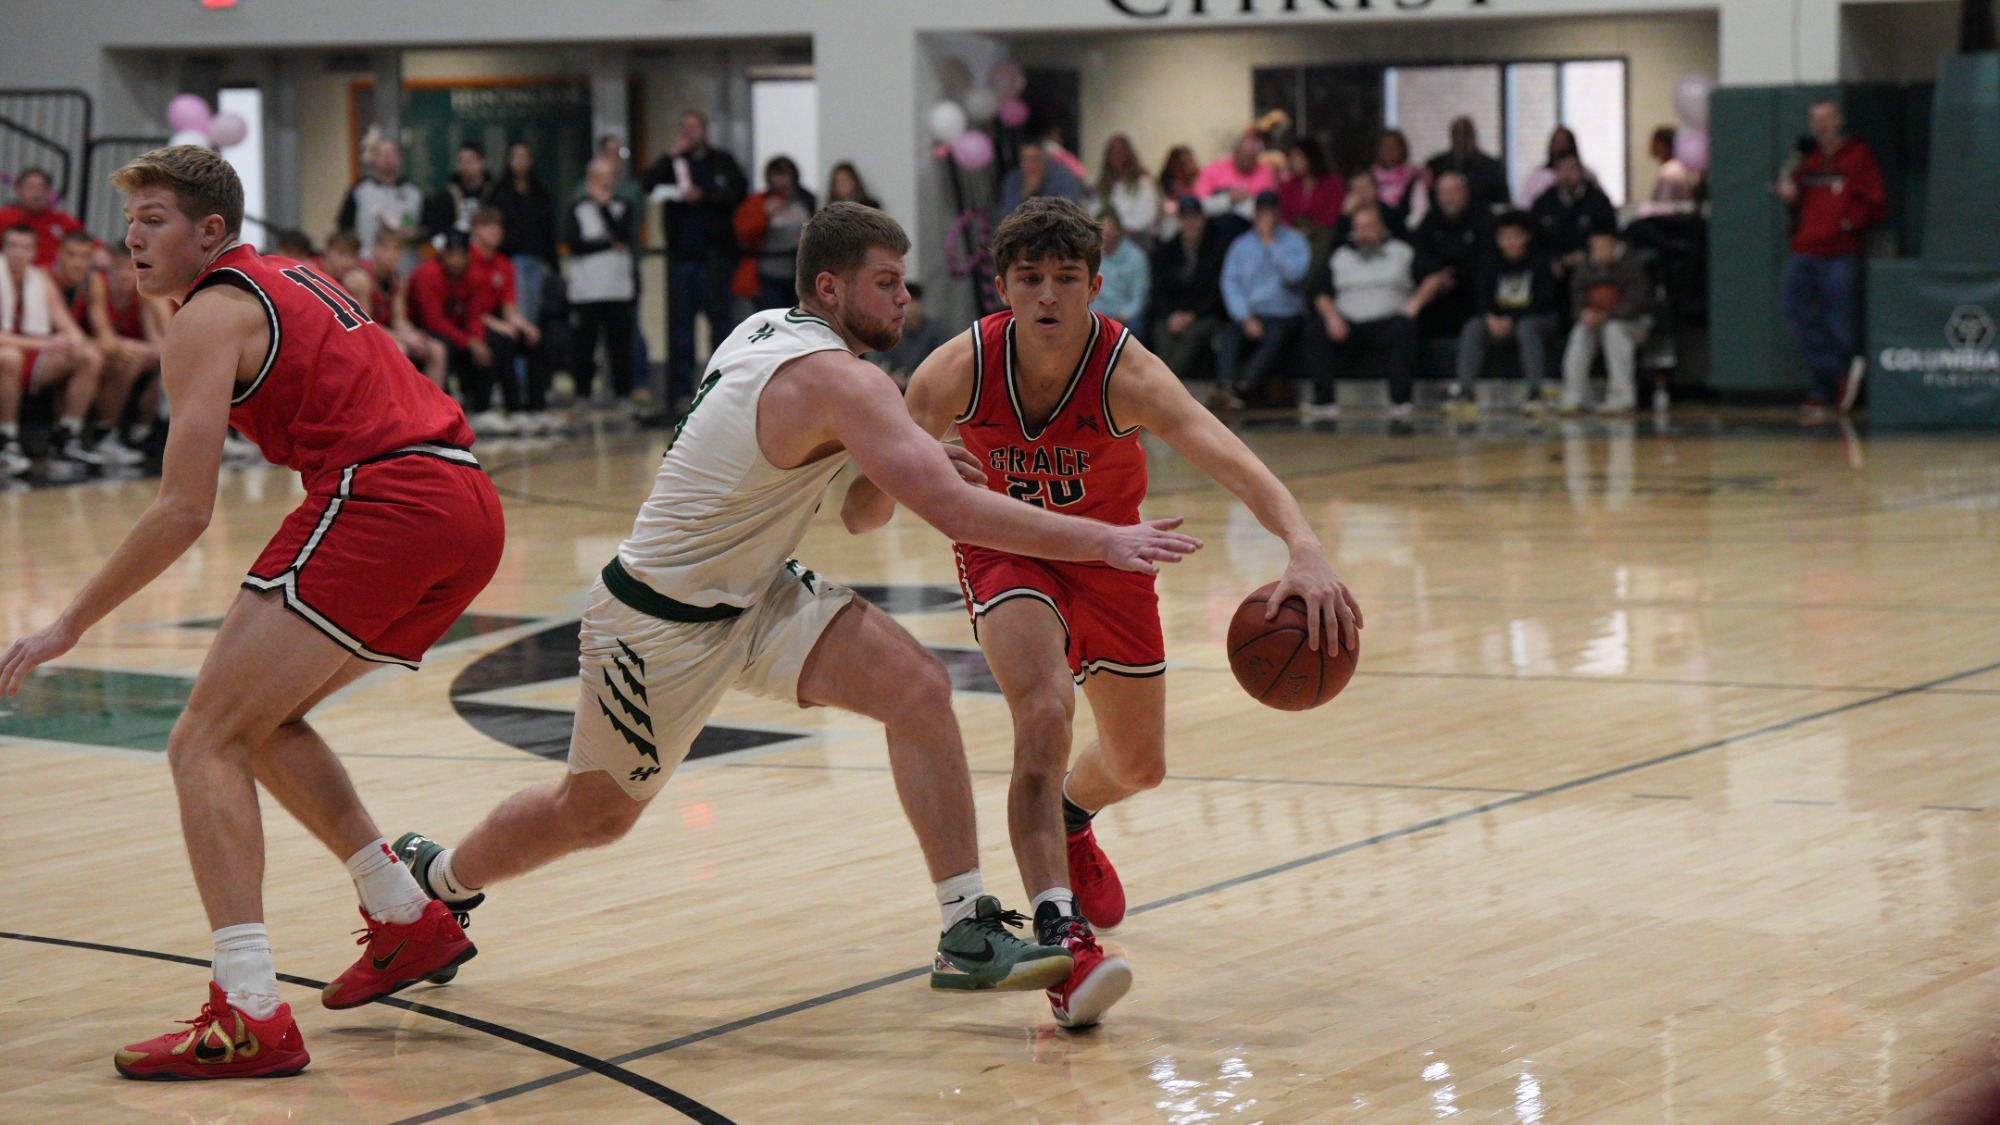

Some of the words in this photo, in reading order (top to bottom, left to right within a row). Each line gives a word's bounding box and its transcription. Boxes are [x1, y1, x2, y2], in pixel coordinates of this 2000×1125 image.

[279, 265, 374, 332] 11
[990, 445, 1091, 476] GRACE
[1006, 475, 1086, 510] 20
